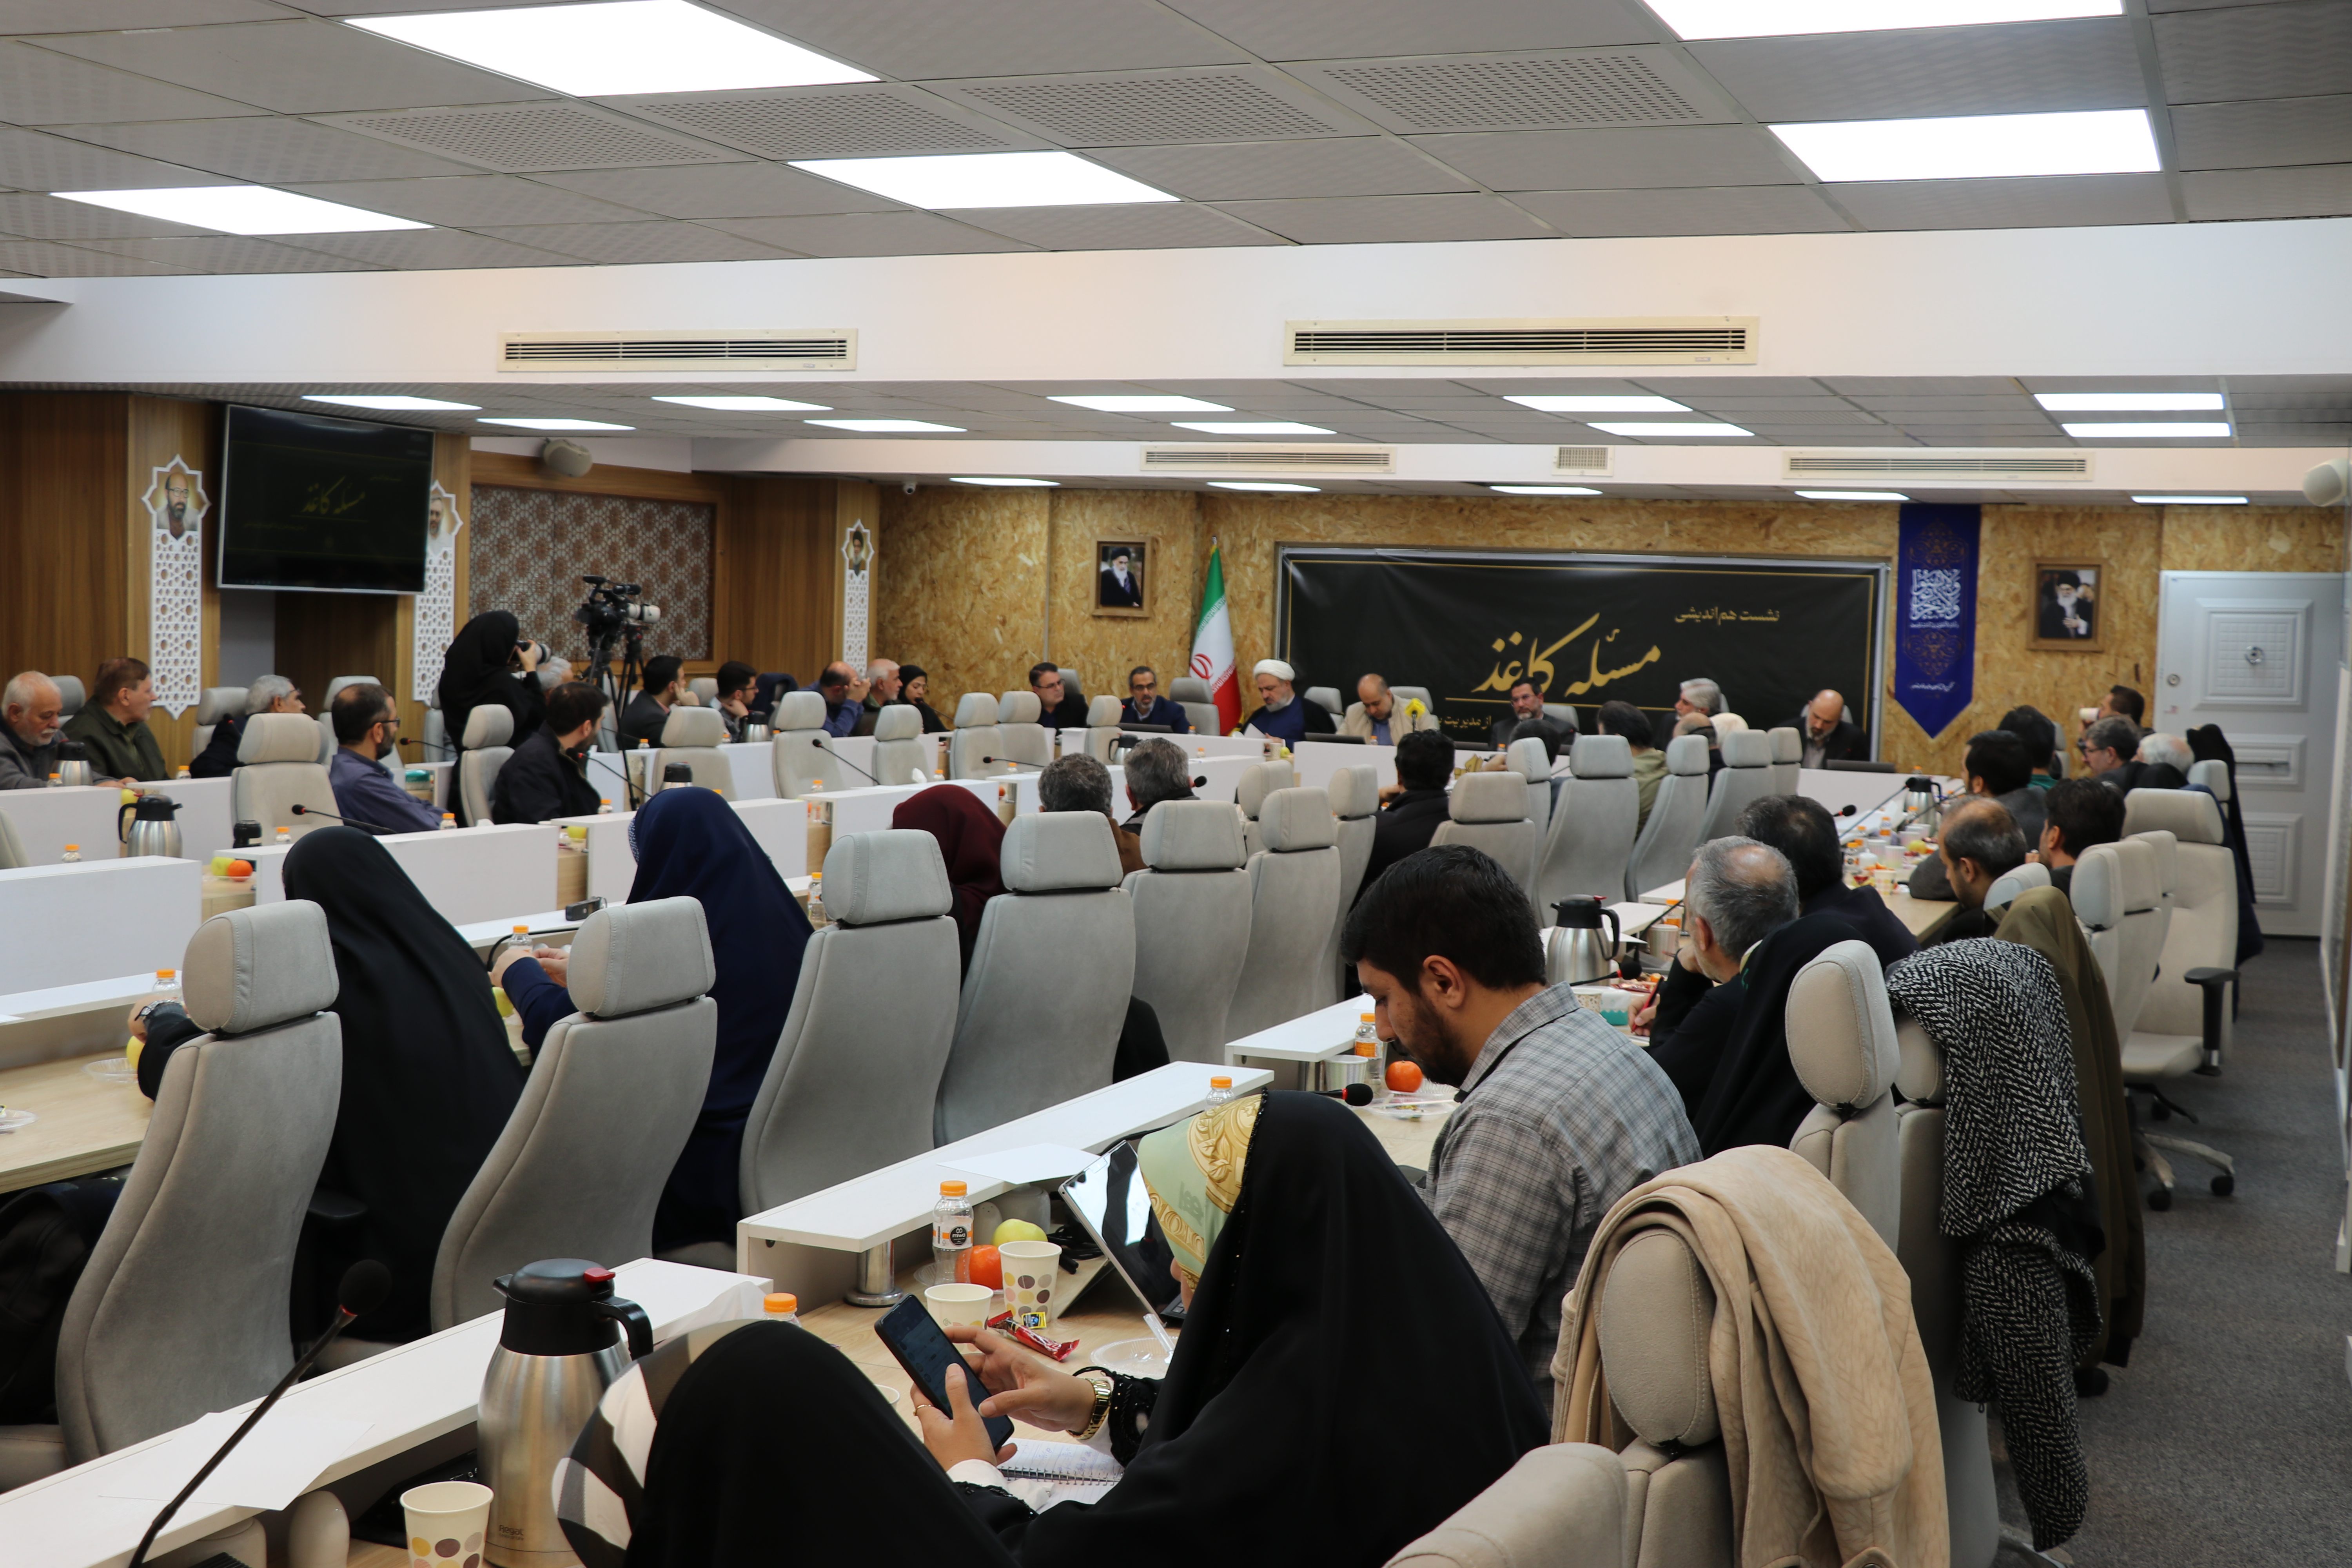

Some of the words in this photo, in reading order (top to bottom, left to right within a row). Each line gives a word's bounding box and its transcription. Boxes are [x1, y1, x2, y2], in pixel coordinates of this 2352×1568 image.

[1739, 608, 1780, 622] نشست
[1471, 612, 1600, 693] کاغذ
[1564, 628, 1661, 697] مسئله
[499, 1524, 524, 1536] Regal
